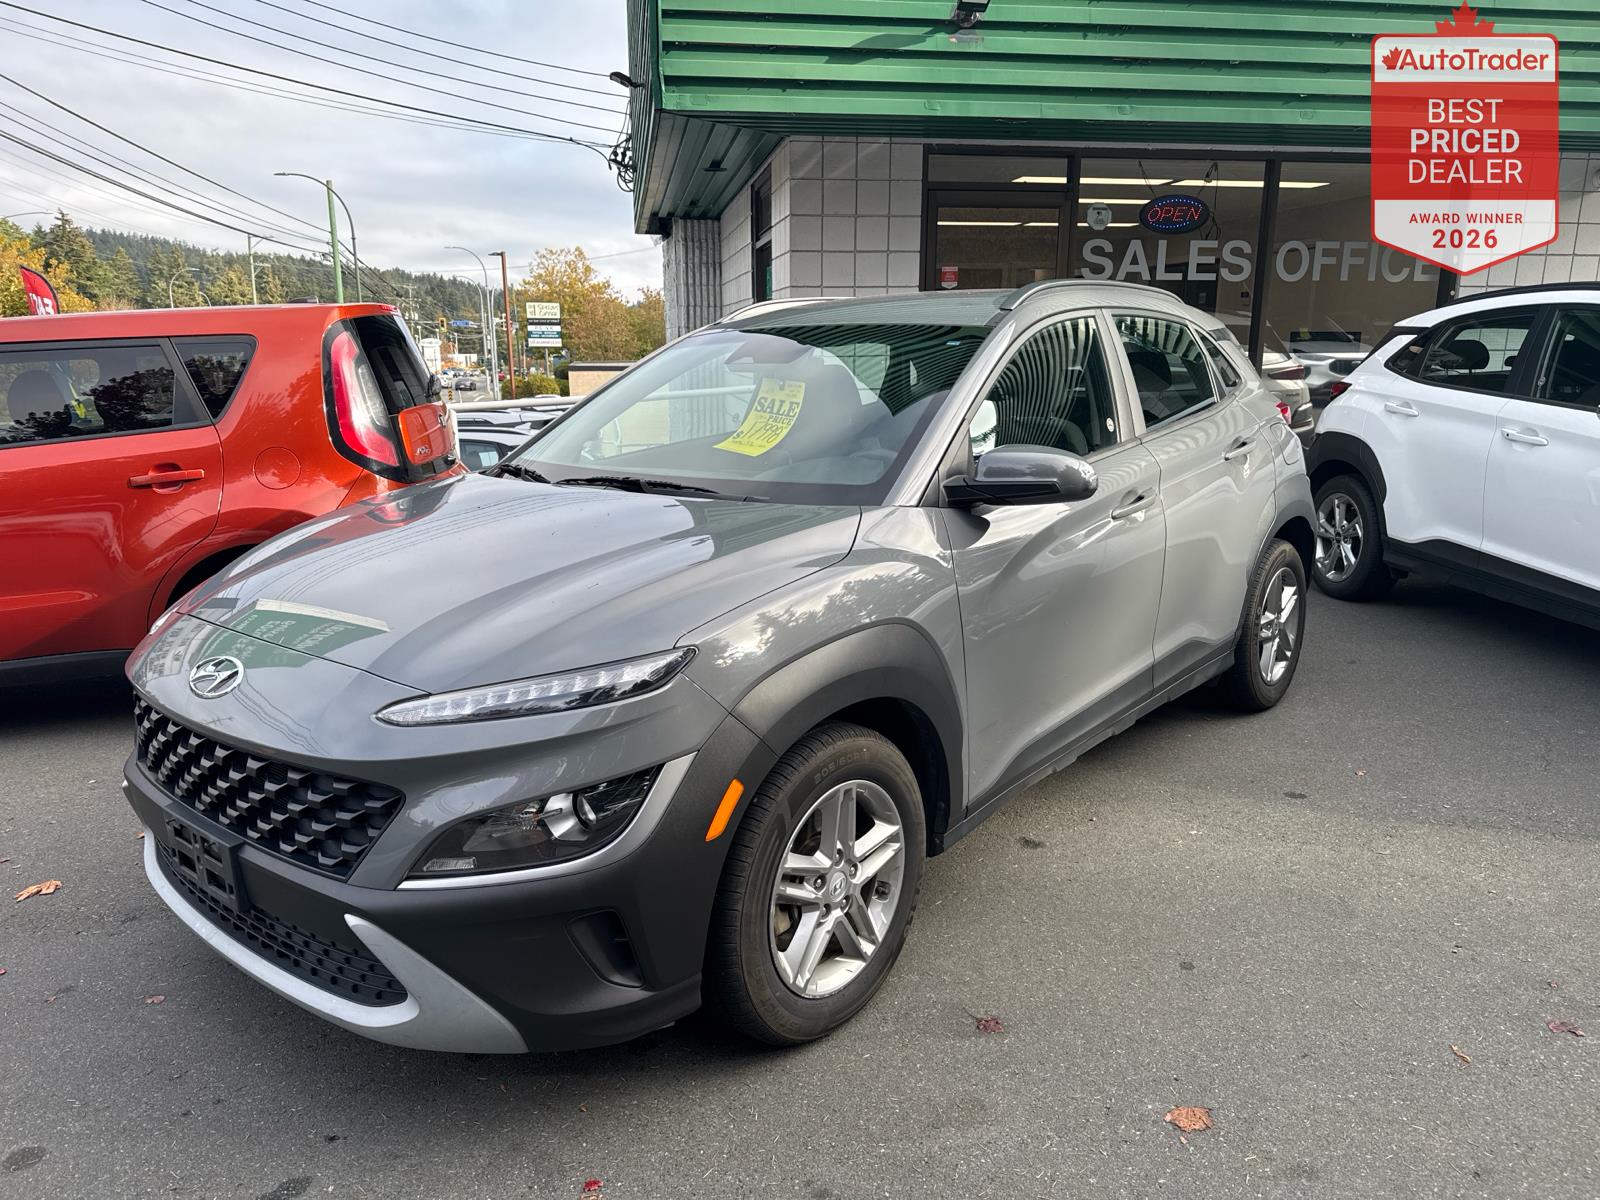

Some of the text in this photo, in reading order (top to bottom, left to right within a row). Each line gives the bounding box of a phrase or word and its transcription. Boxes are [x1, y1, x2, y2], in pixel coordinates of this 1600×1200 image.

[1146, 205, 1201, 222] OPEN
[1081, 239, 1252, 283] SALES
[755, 396, 800, 418] SALE
[767, 414, 794, 426] PRICE
